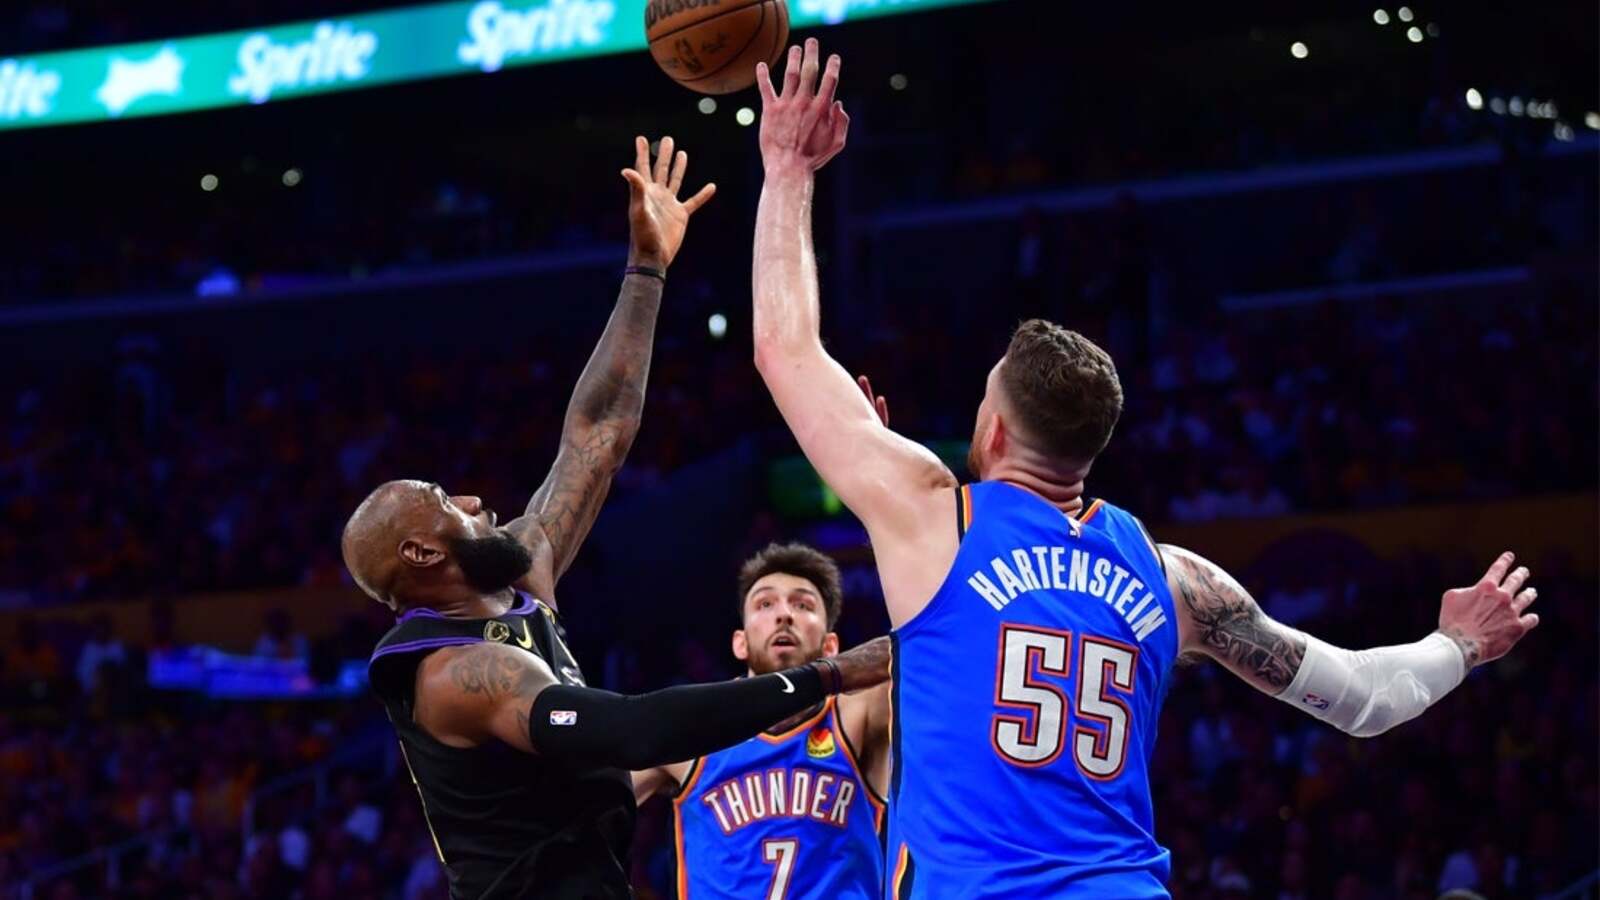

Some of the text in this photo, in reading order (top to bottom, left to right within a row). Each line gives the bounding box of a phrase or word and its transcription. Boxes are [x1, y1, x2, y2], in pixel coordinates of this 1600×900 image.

[228, 20, 377, 104] Sprite
[457, 0, 616, 73] Sprite
[967, 545, 1168, 643] HARTENSTEIN
[991, 622, 1140, 781] 55
[703, 768, 856, 836] THUNDER
[762, 837, 799, 900] 7
